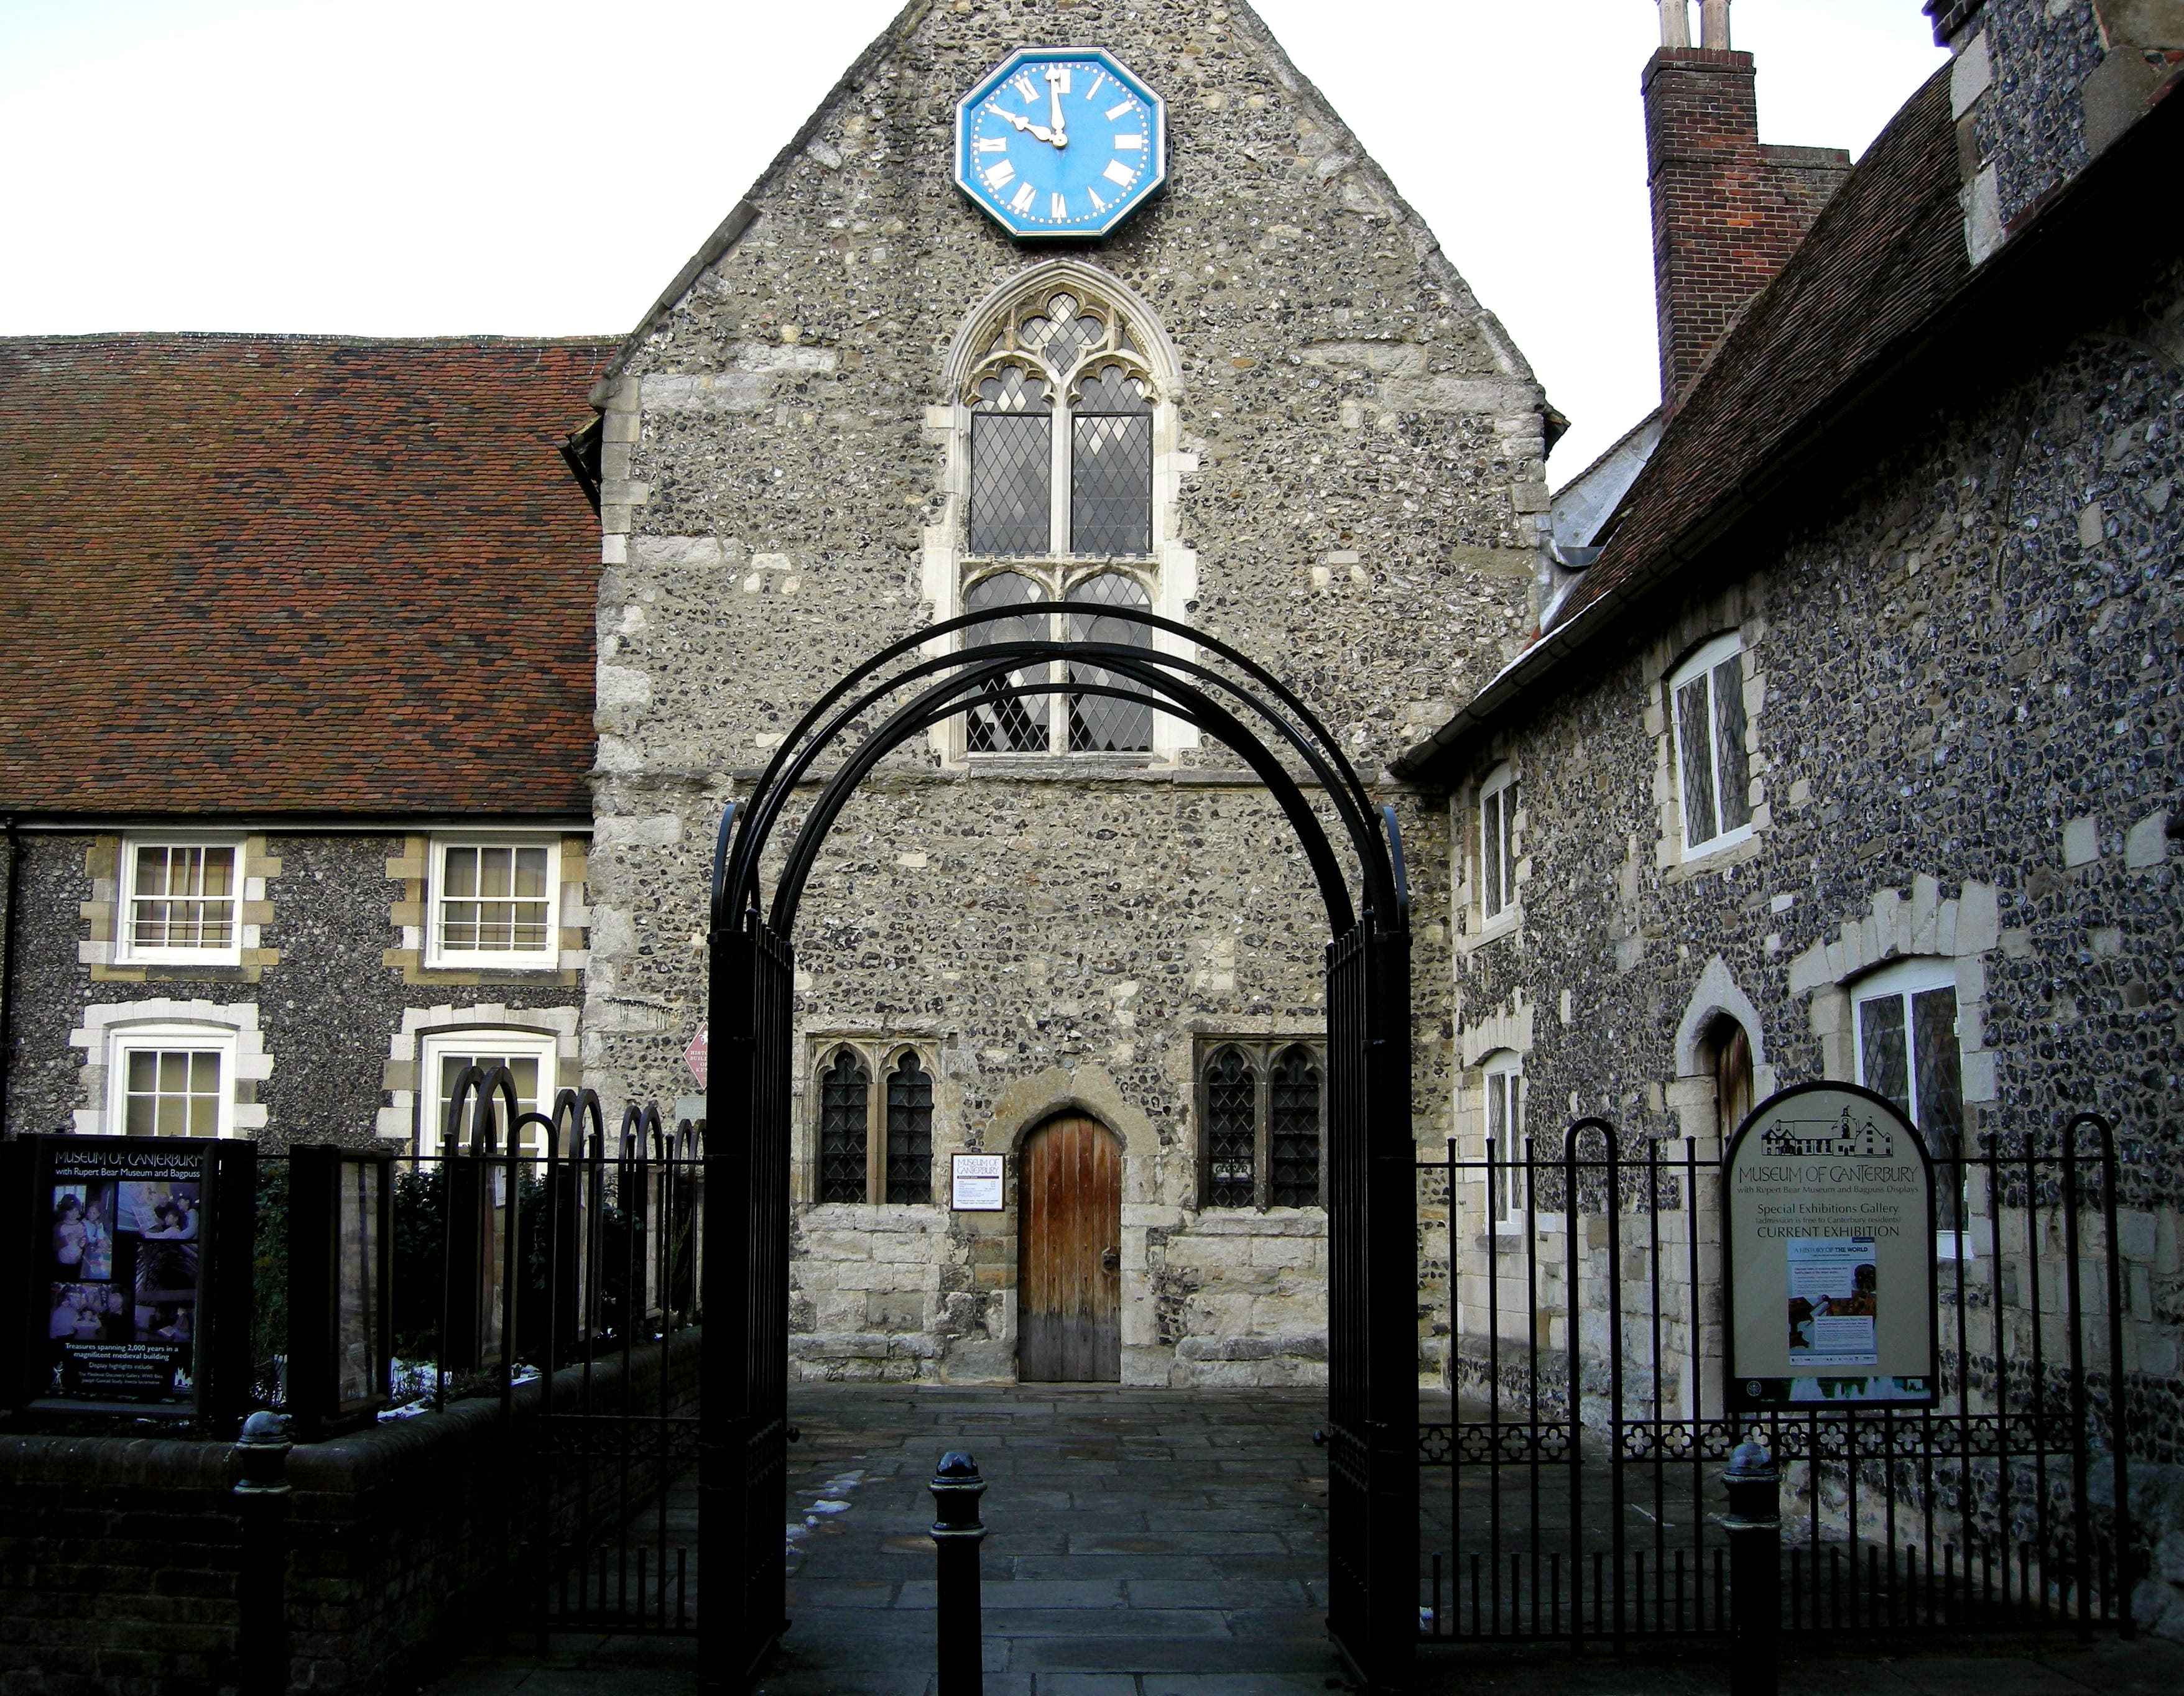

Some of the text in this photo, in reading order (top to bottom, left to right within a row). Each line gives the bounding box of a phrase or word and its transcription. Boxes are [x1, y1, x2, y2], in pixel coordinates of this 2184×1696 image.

[55, 1151, 201, 1167] MUSEUM OF CANTERBURY
[957, 1158, 1000, 1166] MUSEUM OF
[55, 1167, 201, 1179] with Rupert Bear Museum and Bagpuss
[956, 1166, 999, 1174] CANTERBURY
[1739, 1164, 1919, 1183] MUSEUM OF CANTERBURY
[1756, 1186, 1781, 1196] Rupert
[1853, 1186, 1884, 1195] Bagpuss
[1887, 1185, 1919, 1195] Displays
[1757, 1203, 1899, 1216] Special Exhibitions Gallery
[1827, 1216, 1866, 1225] Canterbury
[1757, 1225, 1900, 1238] CURRENT EXHIBITION
[65, 1342, 96, 1350] Treasures
[97, 1343, 126, 1352] spanning
[73, 1351, 111, 1359] magnificent
[143, 1353, 170, 1362] building
